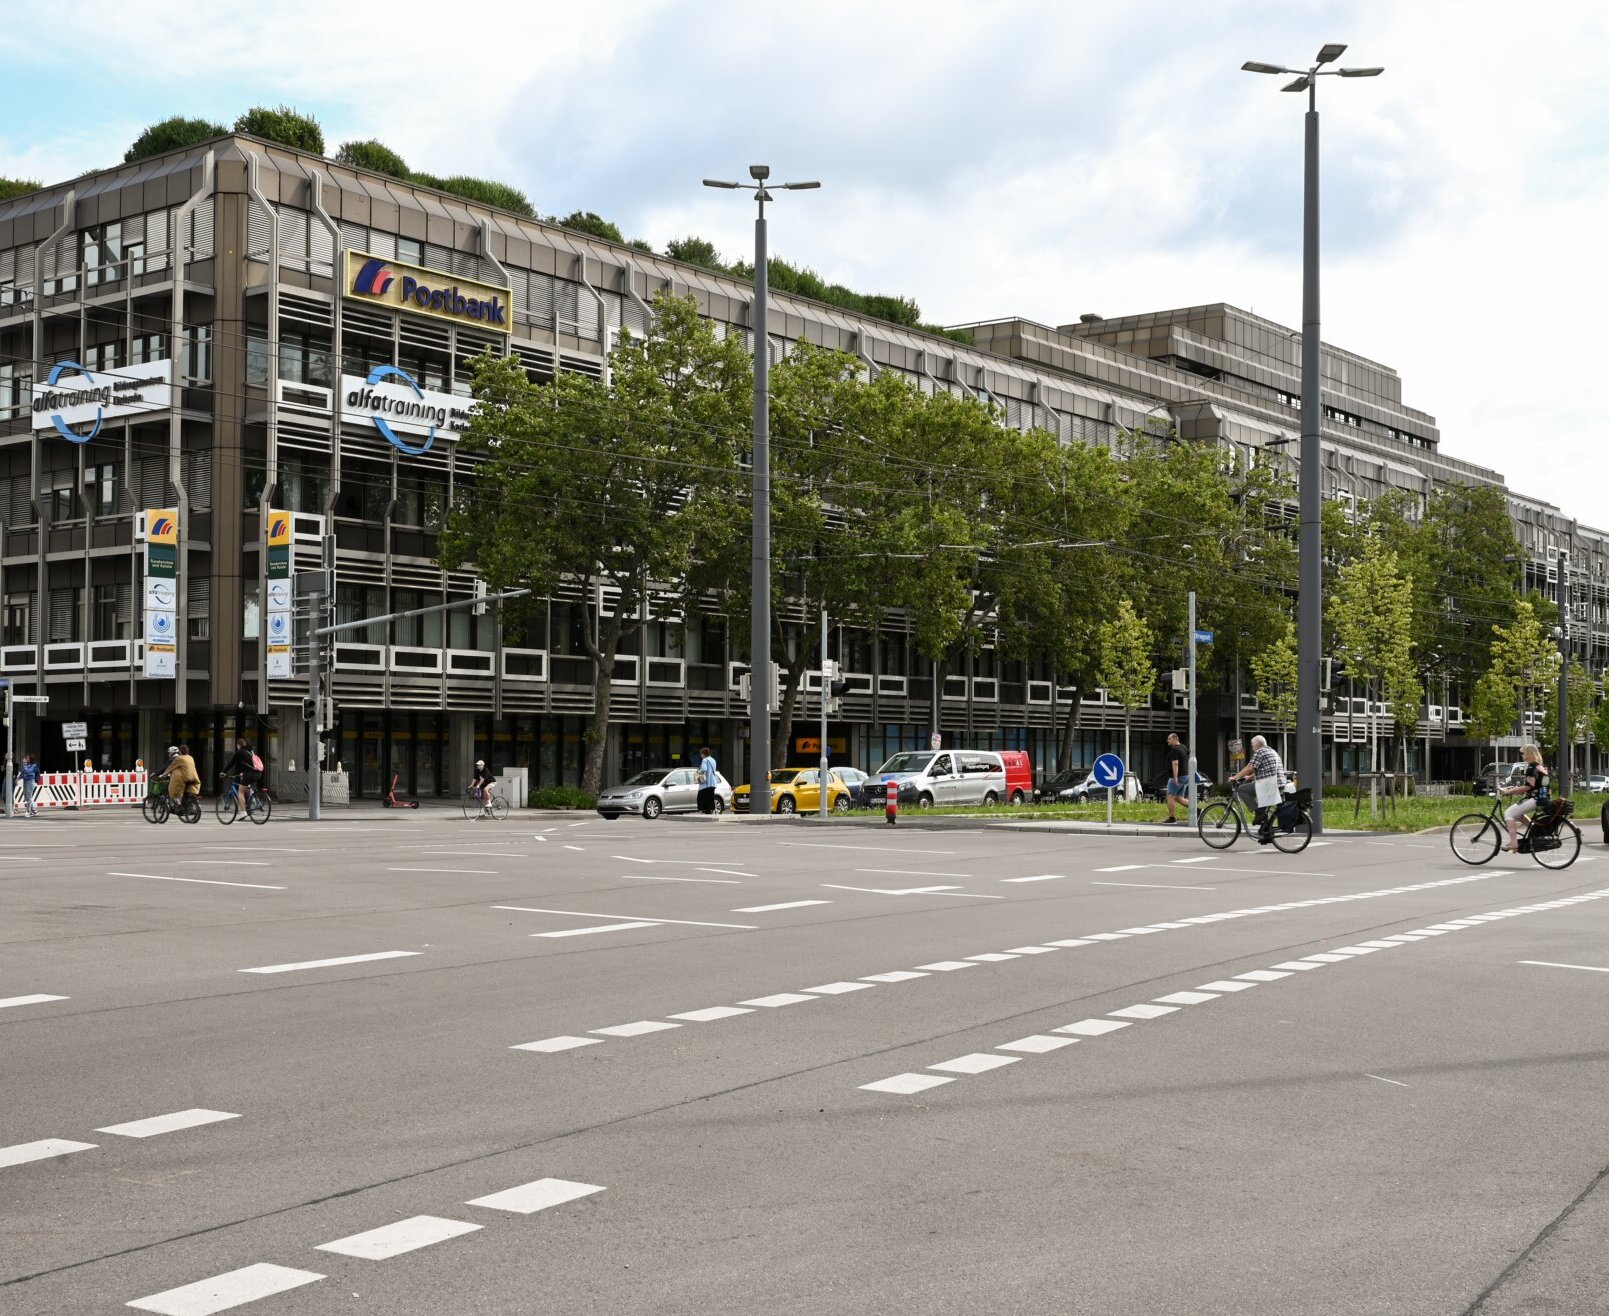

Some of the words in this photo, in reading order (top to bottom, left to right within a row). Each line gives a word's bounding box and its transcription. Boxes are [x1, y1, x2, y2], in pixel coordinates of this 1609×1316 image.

[402, 276, 505, 324] Postbank
[33, 385, 111, 412] alfatraining
[347, 387, 447, 428] alfatraining
